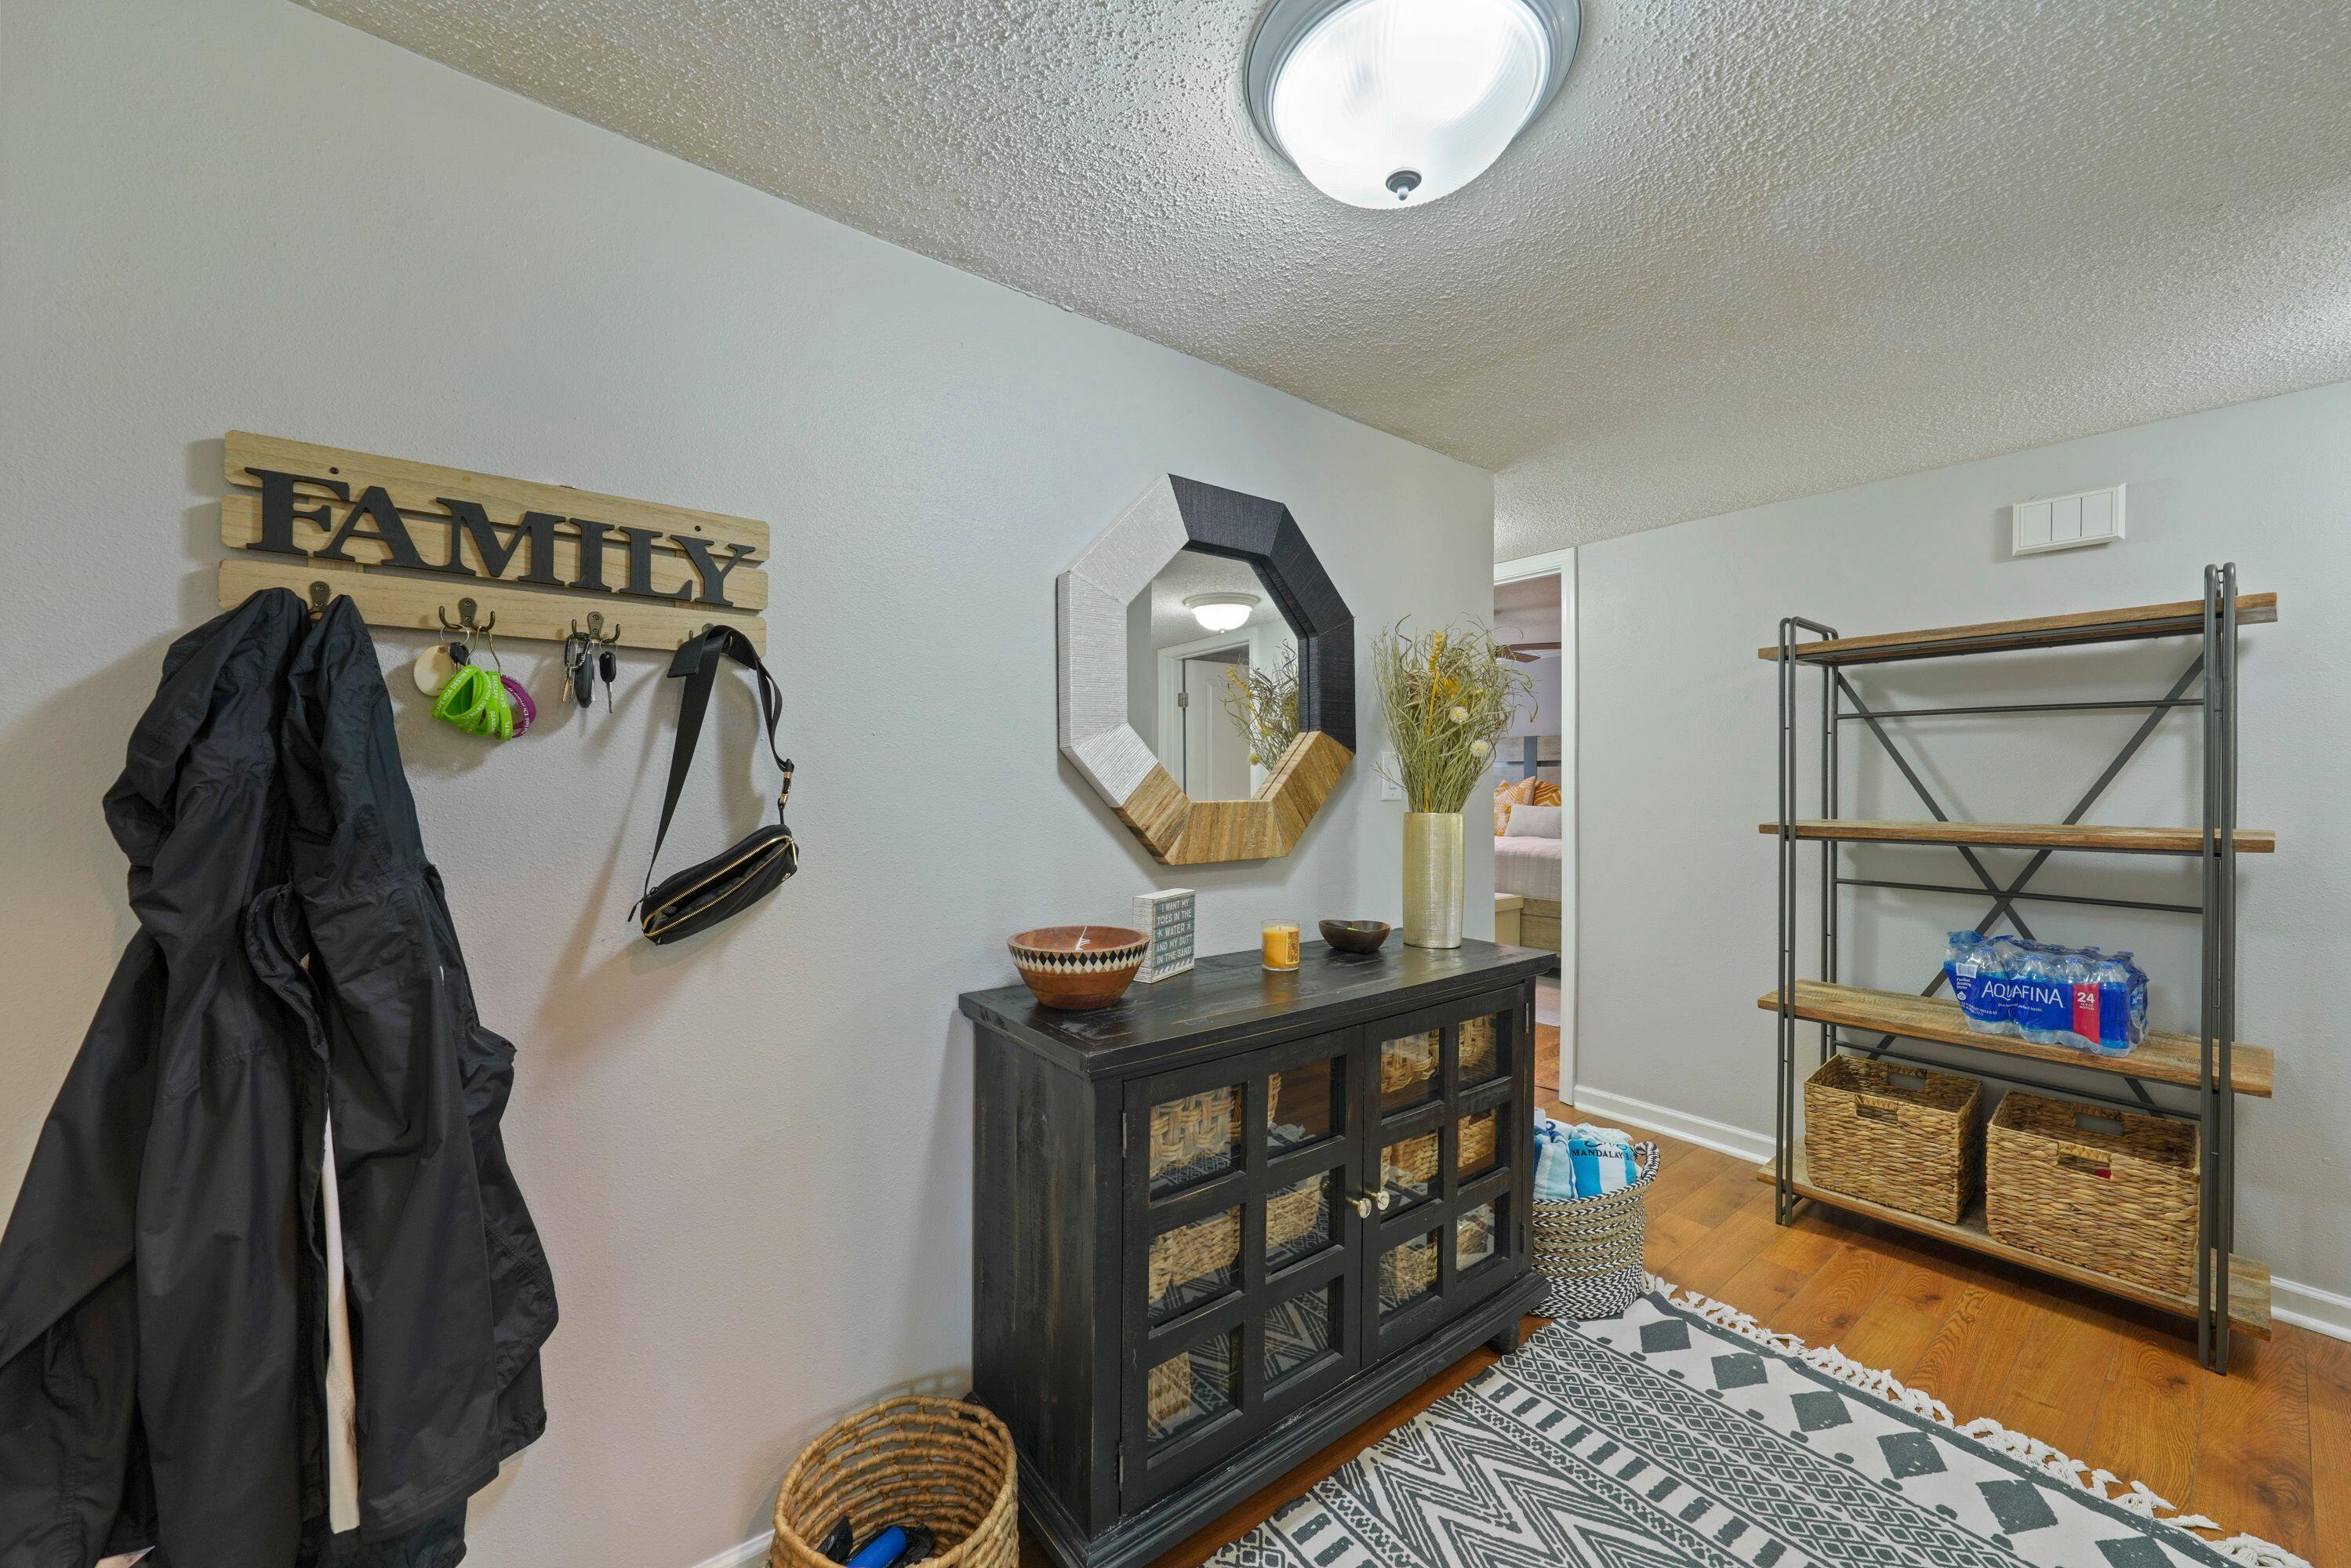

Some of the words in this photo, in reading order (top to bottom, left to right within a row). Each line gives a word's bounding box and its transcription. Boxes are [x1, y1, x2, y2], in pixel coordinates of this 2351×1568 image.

[245, 467, 756, 607] FAMILY
[1161, 904, 1164, 913] I
[1165, 900, 1180, 912] WANT
[1181, 898, 1190, 908] MY
[1157, 913, 1172, 925] TOES
[1173, 911, 1180, 921] IN
[1181, 909, 1192, 918] THE
[1165, 923, 1185, 937] WATER
[1157, 942, 1168, 953] AND
[1169, 938, 1178, 949] MY
[1179, 934, 1193, 946] BUTT
[1157, 954, 1163, 964] IN
[1165, 950, 1176, 961] THE
[1177, 946, 1192, 958] SAND
[1981, 980, 2064, 1008] AQUAFINA
[2077, 992, 2095, 1004] 24
[1572, 1148, 1623, 1159] MANDALAY
